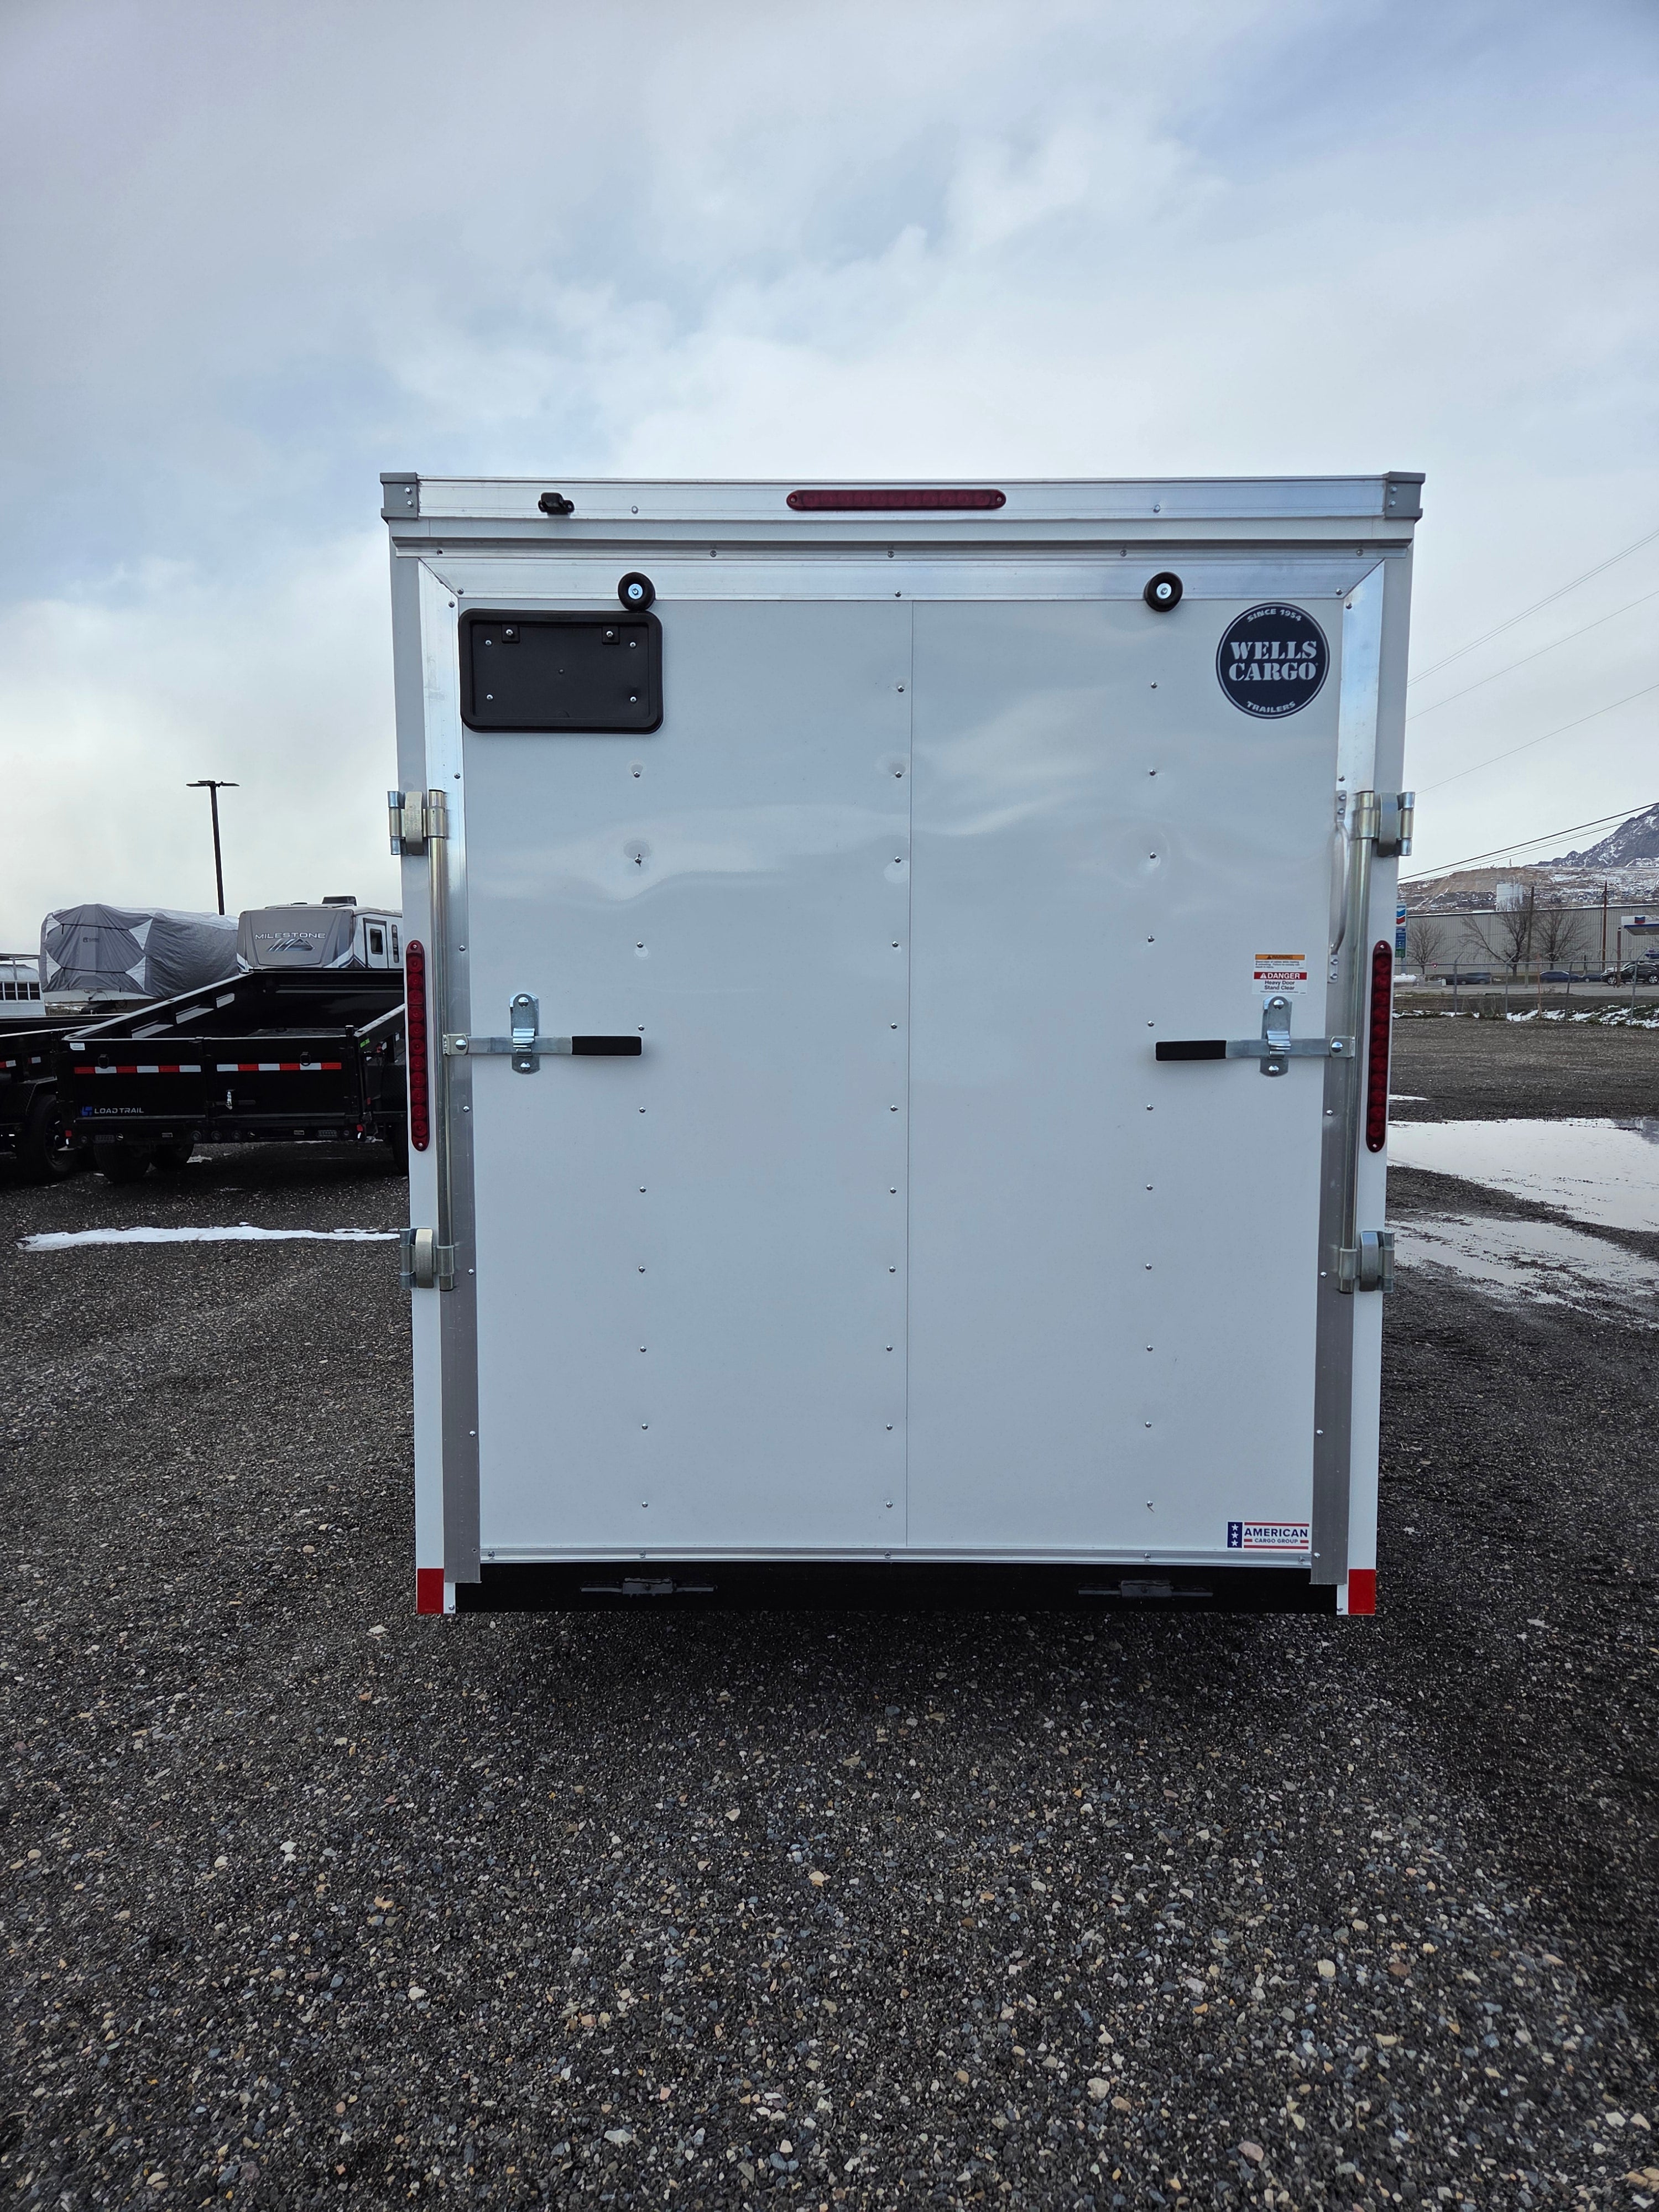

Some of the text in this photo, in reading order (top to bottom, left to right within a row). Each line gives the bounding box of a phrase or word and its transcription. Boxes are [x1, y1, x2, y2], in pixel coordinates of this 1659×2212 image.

[1246, 608, 1302, 622] SINCE 1954
[1230, 641, 1317, 660] WELLS
[1229, 662, 1316, 681] CARGO
[1246, 701, 1296, 713] TRAILERS
[1244, 1528, 1308, 1537] AMERICAN
